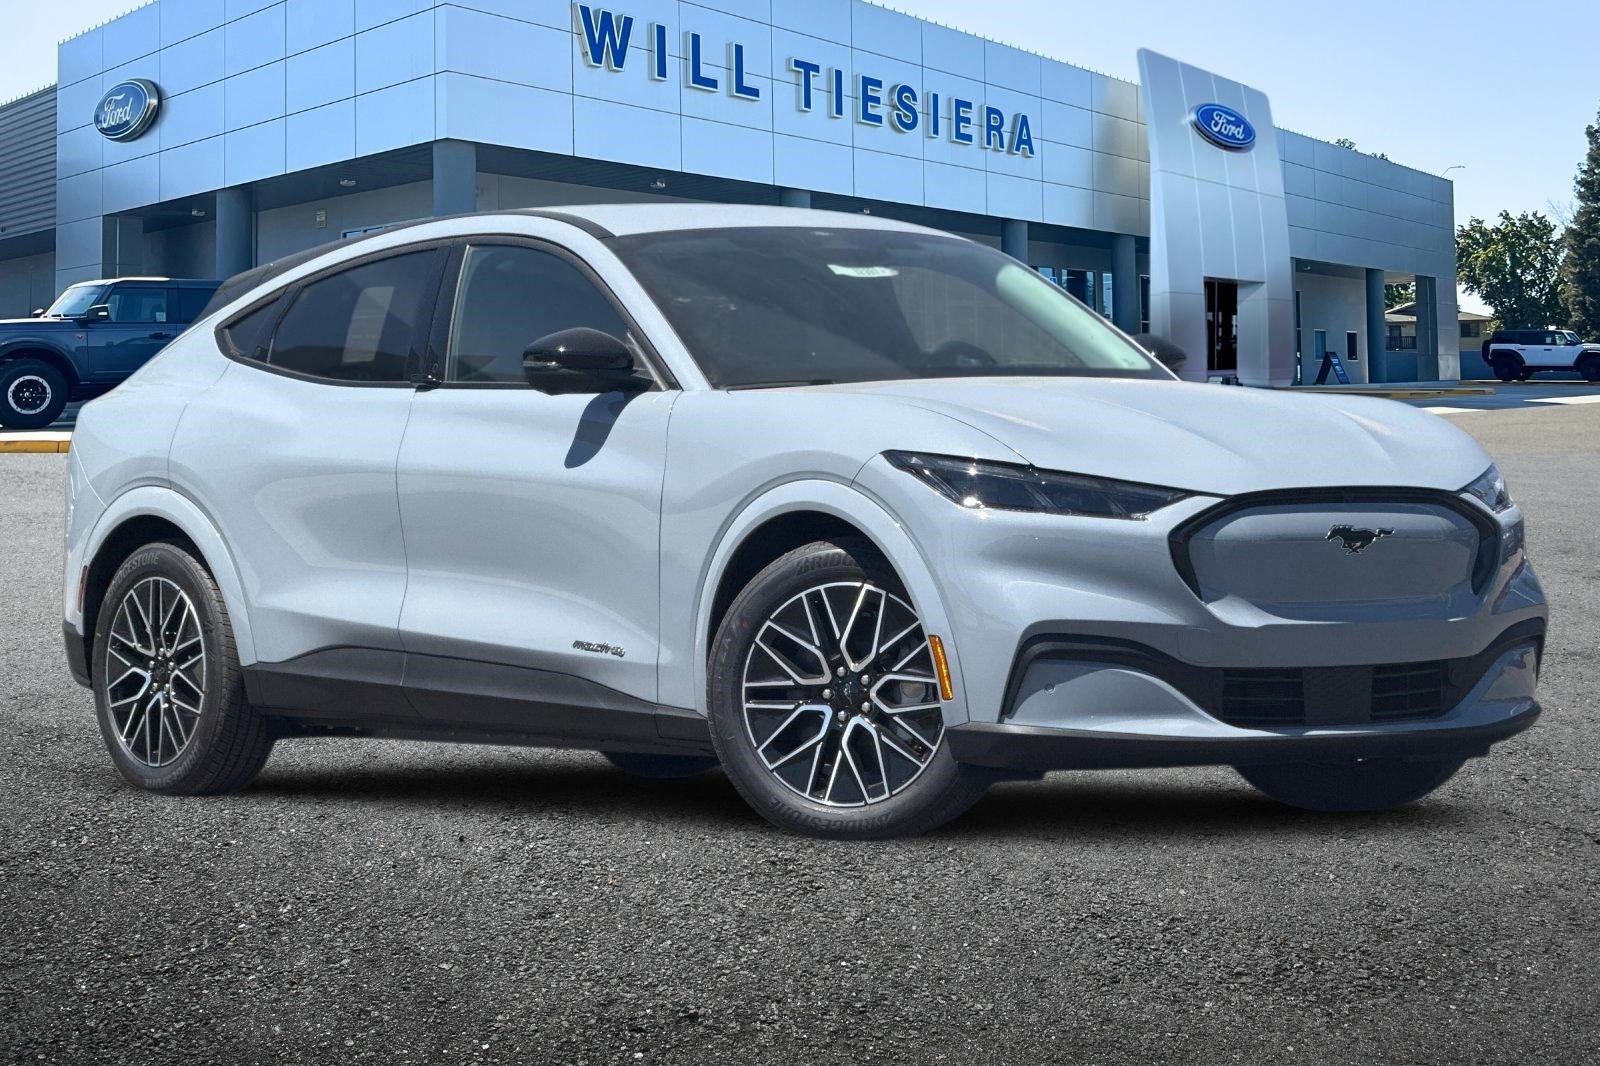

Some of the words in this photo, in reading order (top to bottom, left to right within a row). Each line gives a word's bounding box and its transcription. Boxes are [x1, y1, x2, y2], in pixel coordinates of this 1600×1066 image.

[577, 3, 760, 100] WILL
[788, 57, 1035, 157] TIESIERA
[101, 93, 133, 128] Ford
[1211, 110, 1245, 139] Ford
